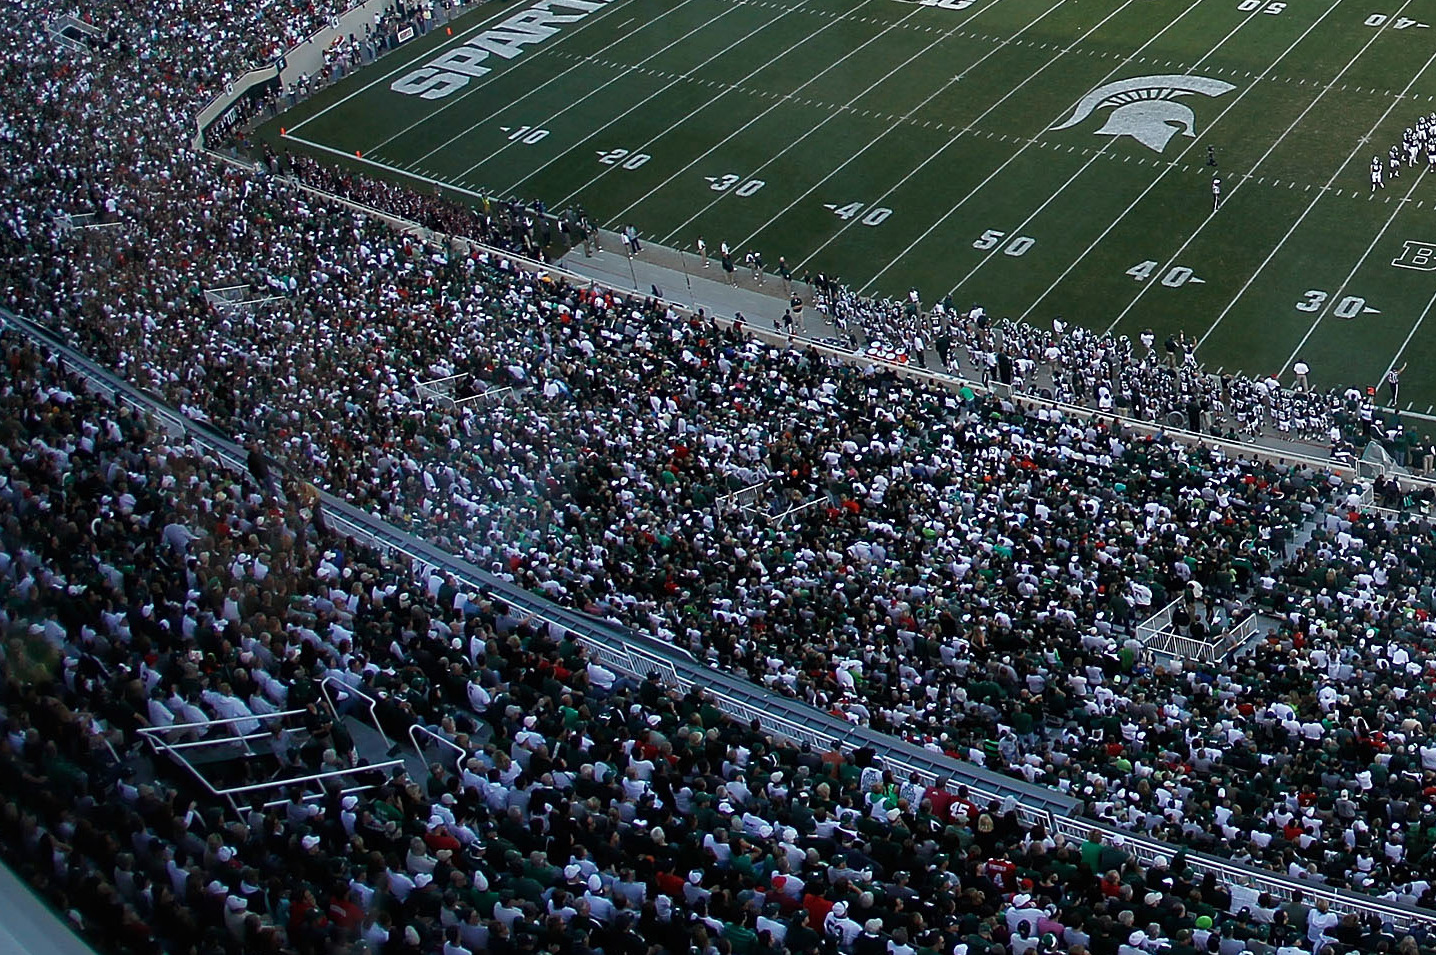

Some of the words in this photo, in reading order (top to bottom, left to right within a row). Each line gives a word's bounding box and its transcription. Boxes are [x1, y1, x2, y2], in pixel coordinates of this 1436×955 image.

[1363, 13, 1418, 30] 40
[510, 124, 551, 145] 10
[600, 148, 652, 170] 20
[708, 173, 766, 198] 30
[832, 201, 894, 227] 40
[972, 229, 1036, 257] 50
[1125, 260, 1194, 289] 40
[1296, 289, 1366, 320] 30
